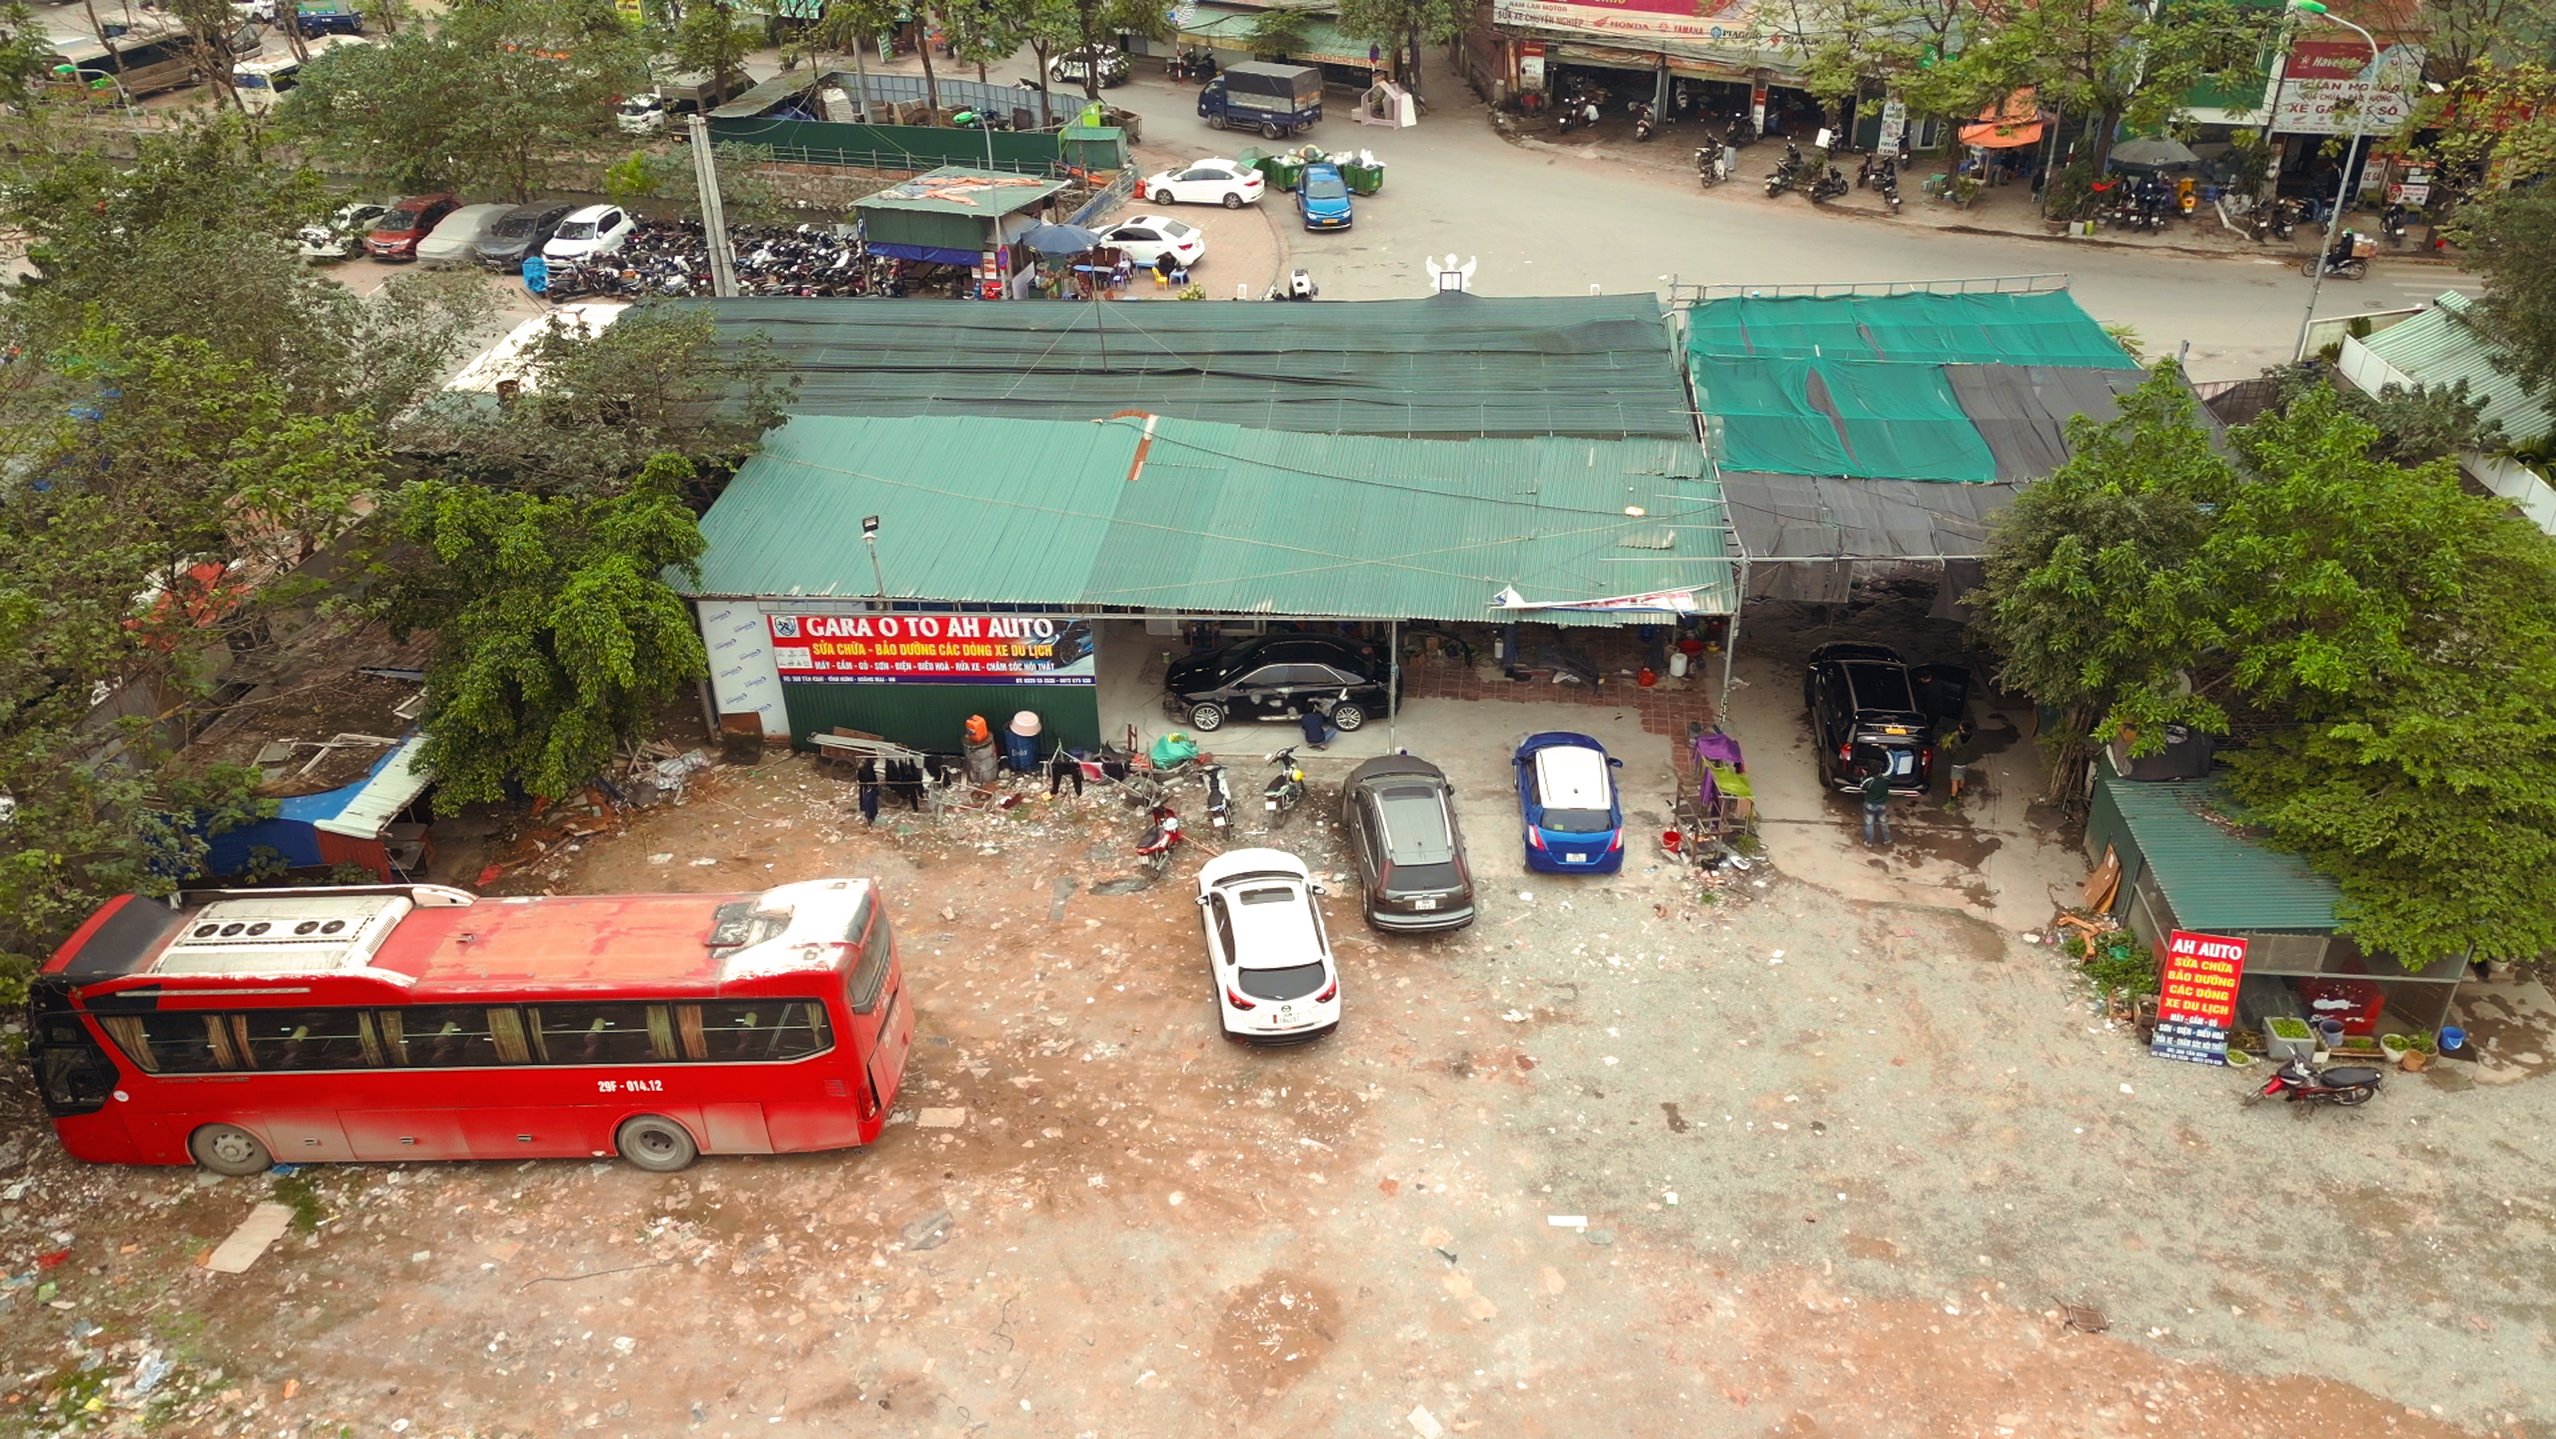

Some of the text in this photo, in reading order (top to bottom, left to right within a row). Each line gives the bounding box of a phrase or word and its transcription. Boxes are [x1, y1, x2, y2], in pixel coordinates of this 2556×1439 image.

[1610, 20, 1650, 30] HONDA
[1674, 25, 1704, 35] YAMAHA
[2288, 104, 2309, 113] XE
[806, 617, 1053, 638] GARA O TO AH AUTO
[812, 640, 835, 655] SỬA
[836, 641, 866, 655] CHỮA
[875, 640, 897, 656] BẢO
[900, 641, 936, 656] DƯỠNG
[938, 642, 961, 656] CÁC
[963, 642, 992, 656] DÒNG
[995, 645, 1009, 656] XE
[1012, 645, 1026, 657] DU
[1029, 645, 1052, 659] LỊCH
[2172, 938, 2242, 960] AH AUTO
[2174, 956, 2233, 973] SỬA CHỮA
[2168, 970, 2235, 988] BẢO DƯỠNG
[2169, 984, 2193, 996] CÁC
[2165, 998, 2229, 1015] XE DU LỊCH
[597, 1080, 617, 1092] 29F
[626, 1080, 663, 1092] 014.12
